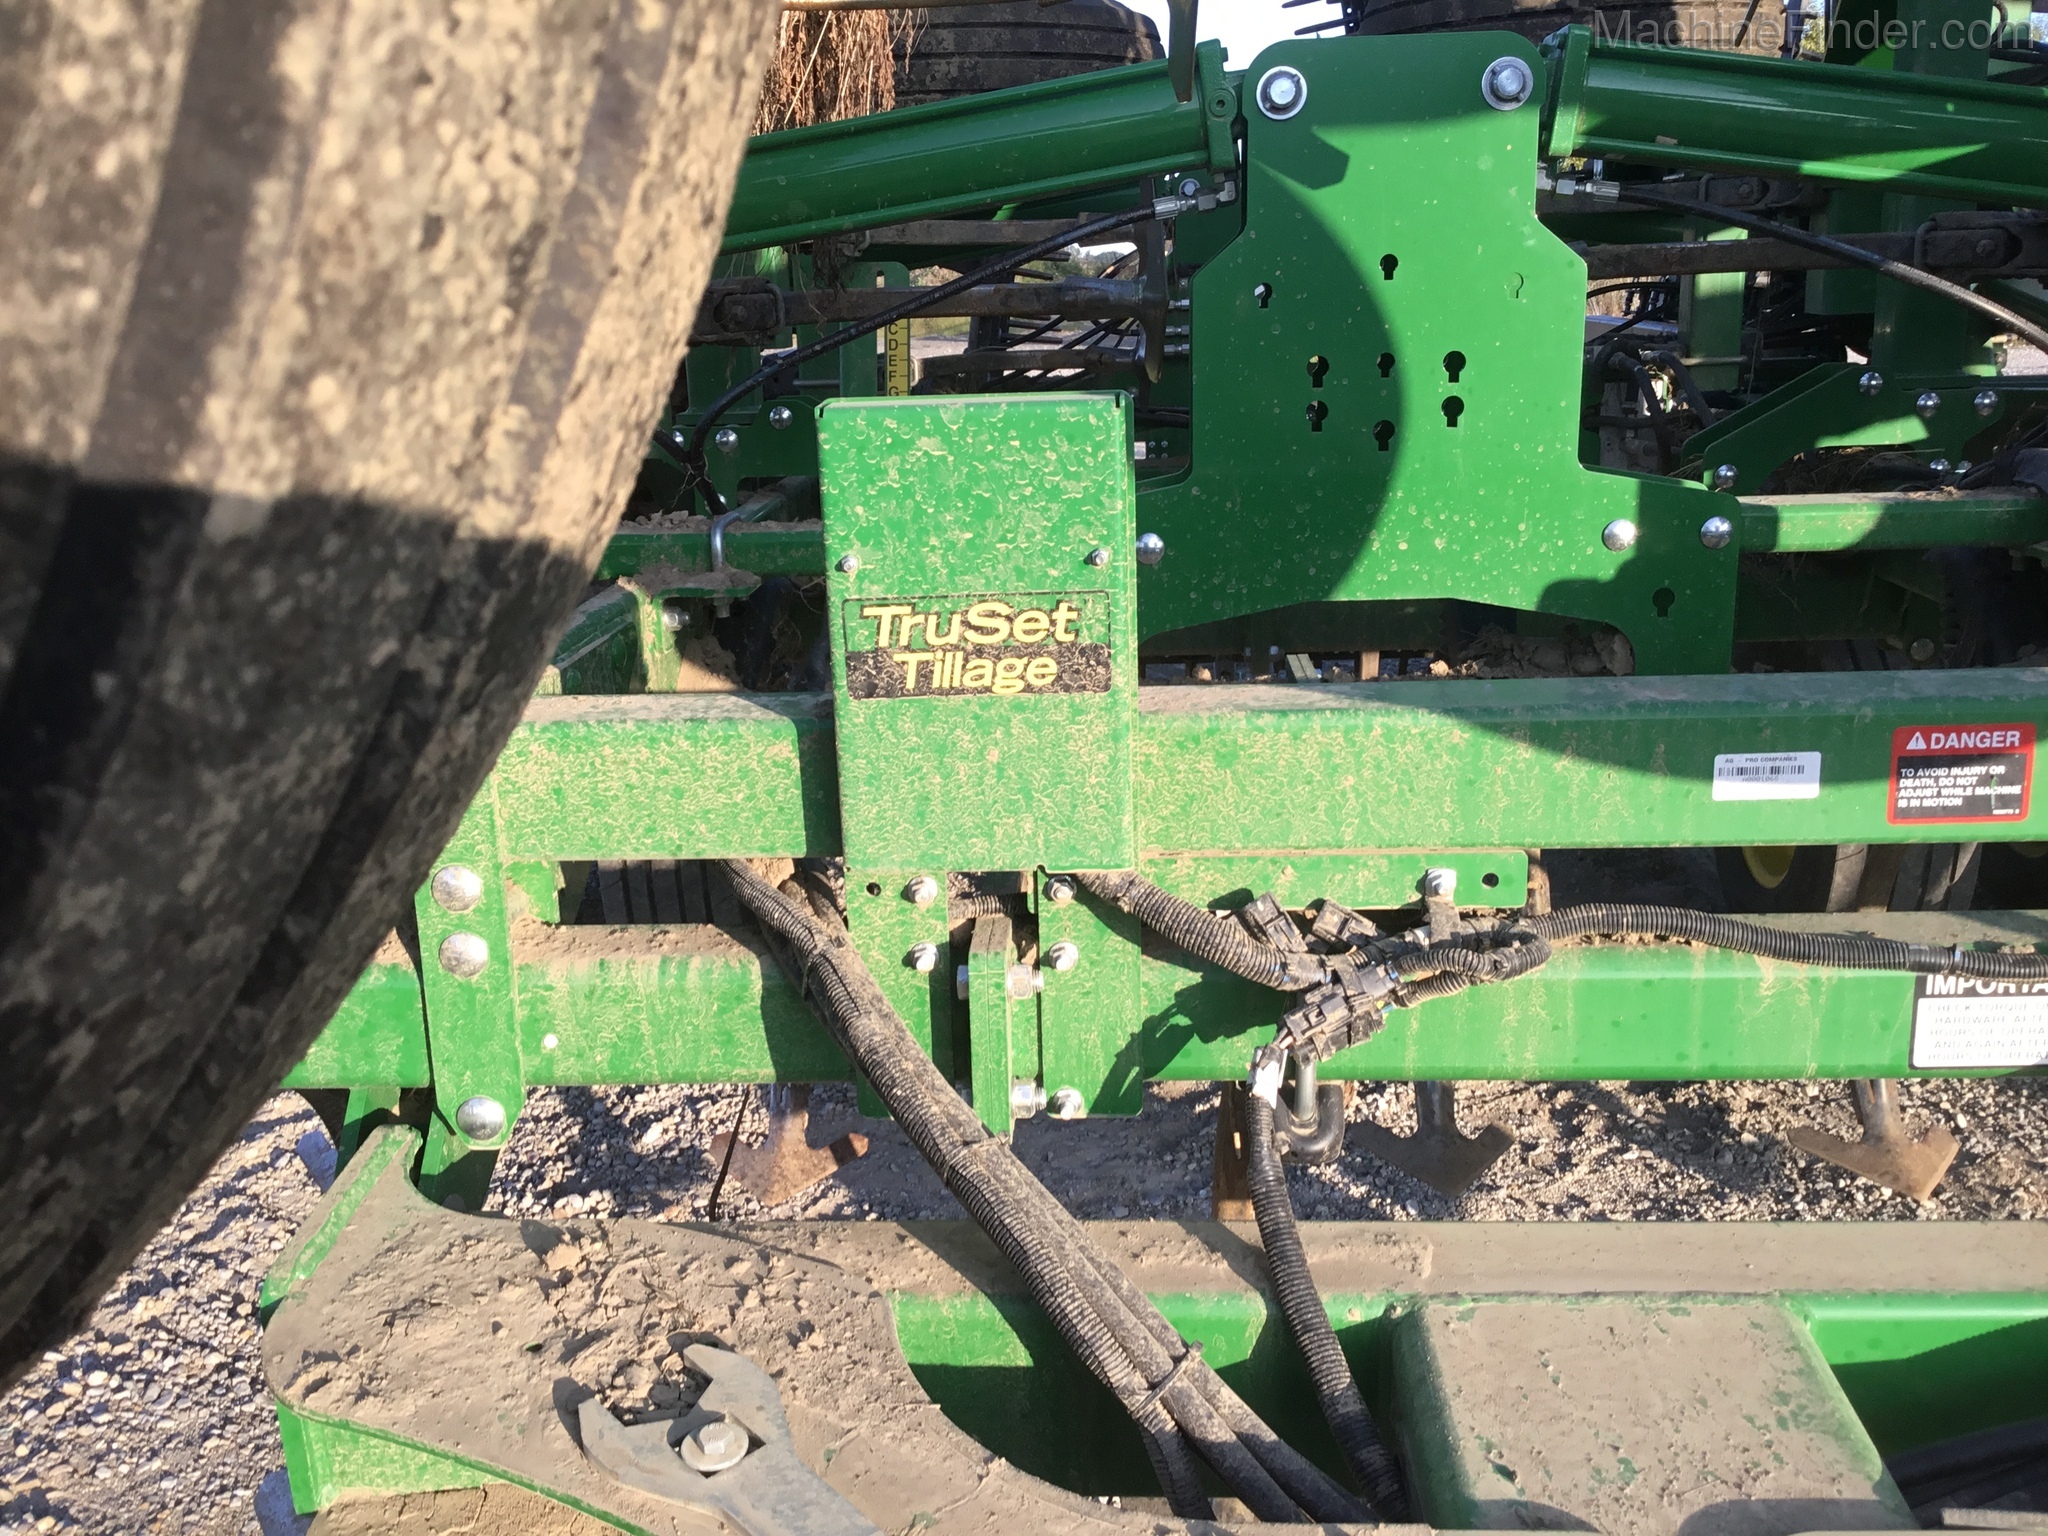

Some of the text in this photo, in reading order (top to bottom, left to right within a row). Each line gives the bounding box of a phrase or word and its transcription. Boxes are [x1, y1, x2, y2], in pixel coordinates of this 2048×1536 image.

[888, 322, 899, 336] C
[888, 338, 899, 351] D
[888, 354, 898, 367] E
[888, 370, 897, 382] F
[862, 601, 1080, 648] TruSet
[893, 650, 1059, 694] Tillage
[1930, 730, 2021, 750] DANGER
[1900, 765, 2006, 777] TO AVOID INJURY OR
[1899, 776, 1979, 787] DEATH, DO NOT
[1898, 785, 2022, 797] ADJUST WHILE MACHINE
[1897, 797, 1963, 808] IS IN MOTION
[2013, 1014, 2048, 1023] AFTE
